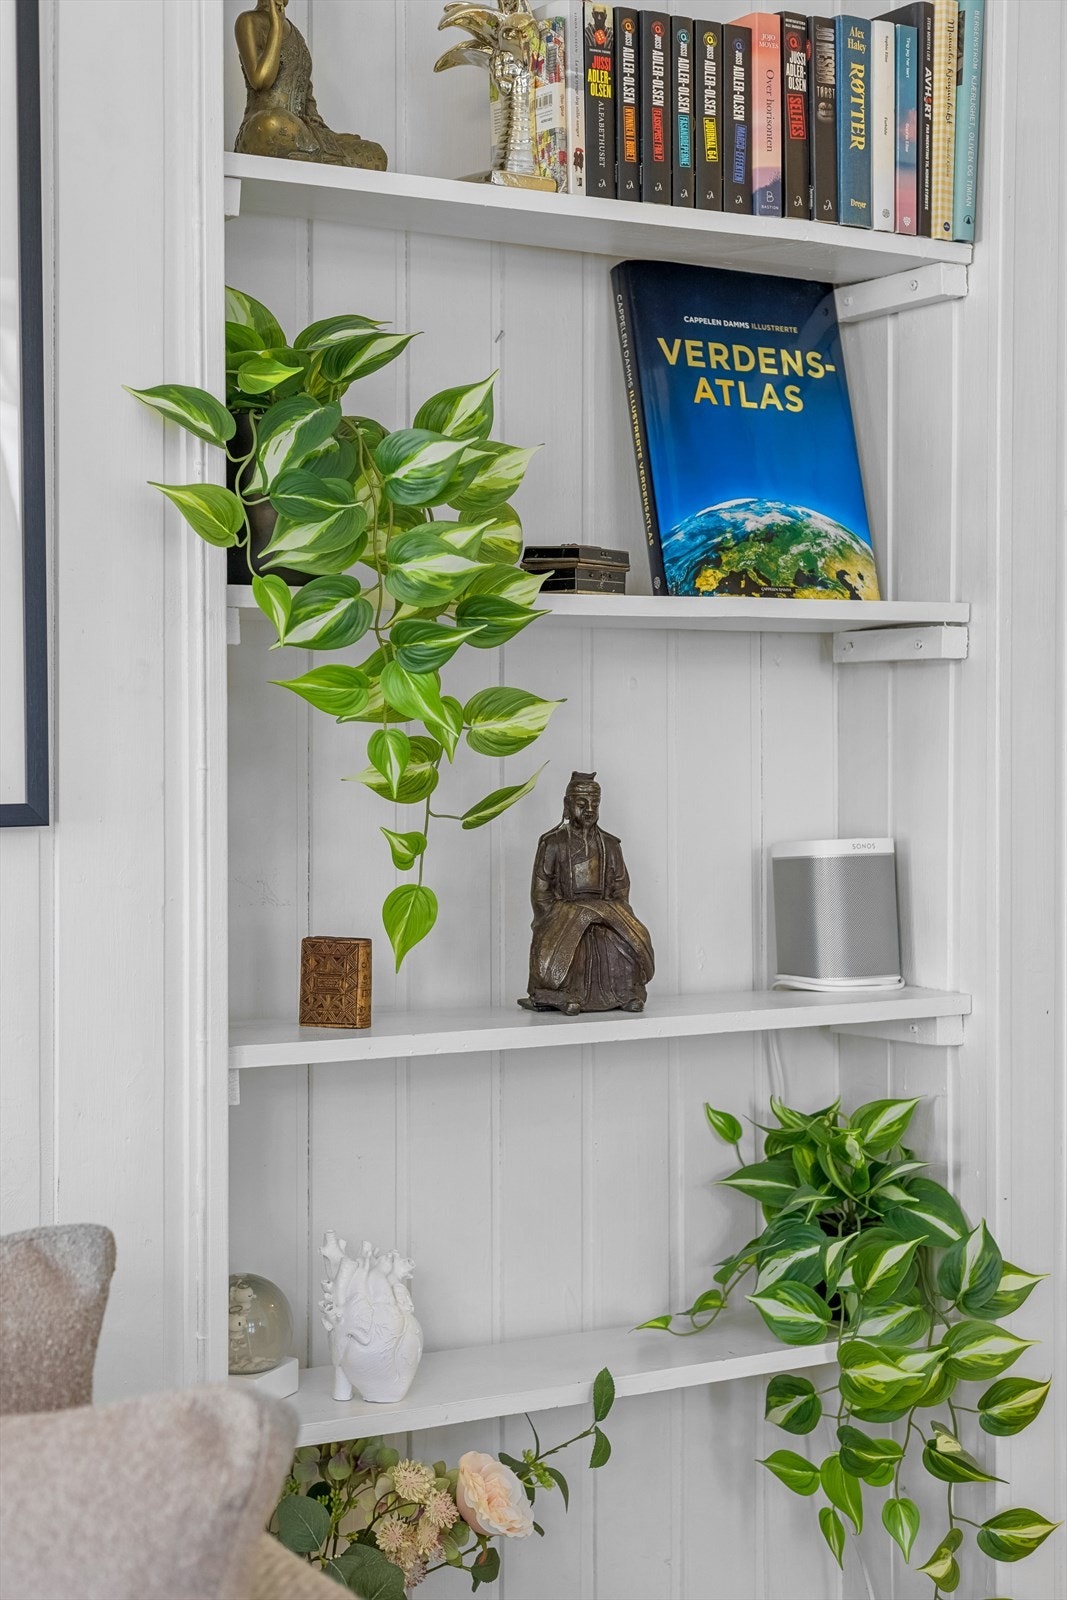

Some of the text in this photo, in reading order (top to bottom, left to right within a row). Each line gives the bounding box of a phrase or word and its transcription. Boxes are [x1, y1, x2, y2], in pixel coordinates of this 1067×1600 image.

[759, 41, 779, 49] MOYES
[761, 34, 776, 42] JOJO
[848, 38, 867, 54] Haley
[850, 26, 865, 39] Alex
[592, 56, 611, 71] JUSSI
[623, 31, 635, 104] JUSSI ADLER-OLSEN
[789, 51, 806, 66] JUSSI
[816, 25, 836, 85] JO NESBØ
[588, 69, 611, 84] ADLER-
[652, 34, 664, 107] JUSSI ADLER-OLSEN
[678, 43, 690, 113] JUSSI ADLER-OLSEN
[704, 45, 716, 116] JUSSI ADLER-OLSEN
[786, 62, 806, 78] ADLER-
[788, 76, 807, 92] OLSEN
[590, 83, 612, 98] OLSEN
[733, 65, 745, 121] ADLER-OLSEN
[766, 69, 775, 152] Over horisonten
[789, 97, 805, 138] SELFIES
[849, 62, 866, 151] RØTTER
[625, 108, 634, 136] KVINNEN
[653, 110, 663, 144] FLASKEPOST
[626, 140, 635, 160] BURET
[654, 144, 663, 154] FRA
[679, 116, 689, 165] FASANDREPERNE
[705, 119, 718, 159] JOURNAL 64
[967, 132, 976, 163] OLIVEN
[734, 126, 746, 182] MARCO-EFFEKTEN
[967, 164, 974, 177] OG
[850, 198, 867, 209] Dreyer
[965, 179, 973, 207] TIMIAN
[683, 316, 798, 334] CAPPELEN DAMMS ILLUSTRERTE
[656, 337, 836, 379] VERDENS-
[693, 376, 804, 413] ATLAS
[616, 294, 654, 546] CAPPELEN DAMMS ILLUSTRERTE VERDENSATLAS
